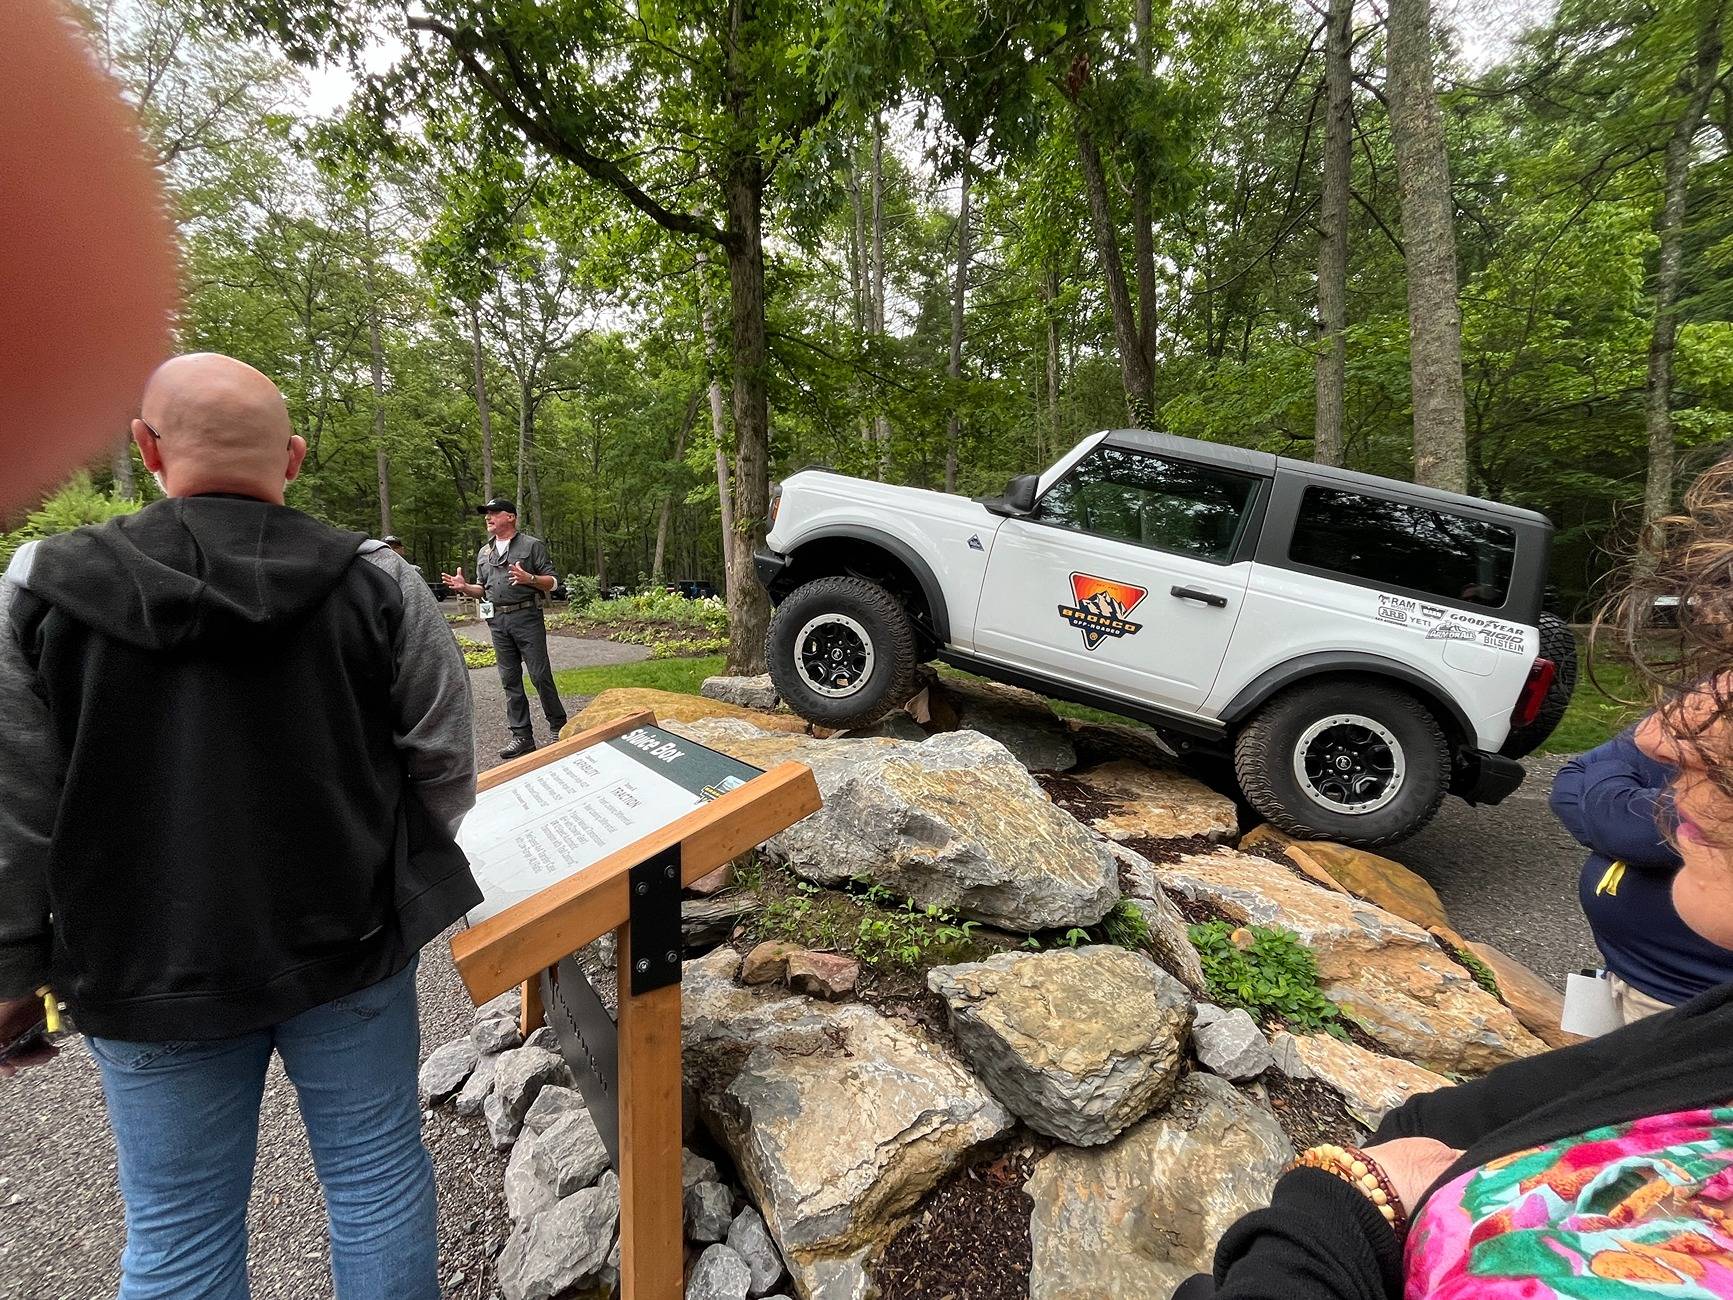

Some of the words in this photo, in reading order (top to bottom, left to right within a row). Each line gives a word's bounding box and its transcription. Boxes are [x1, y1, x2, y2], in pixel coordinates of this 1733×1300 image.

[1391, 597, 1416, 610] RAM
[1062, 608, 1136, 632] BRONCO
[1381, 608, 1405, 620] ARB
[1410, 616, 1432, 627] YETI
[1450, 613, 1525, 635] GOODYEAR
[1478, 629, 1524, 644] RIGID
[1484, 636, 1525, 653] BILSTEIN
[621, 728, 660, 751] Sluice
[650, 742, 685, 763] Box
[610, 786, 641, 809] TRACTION
